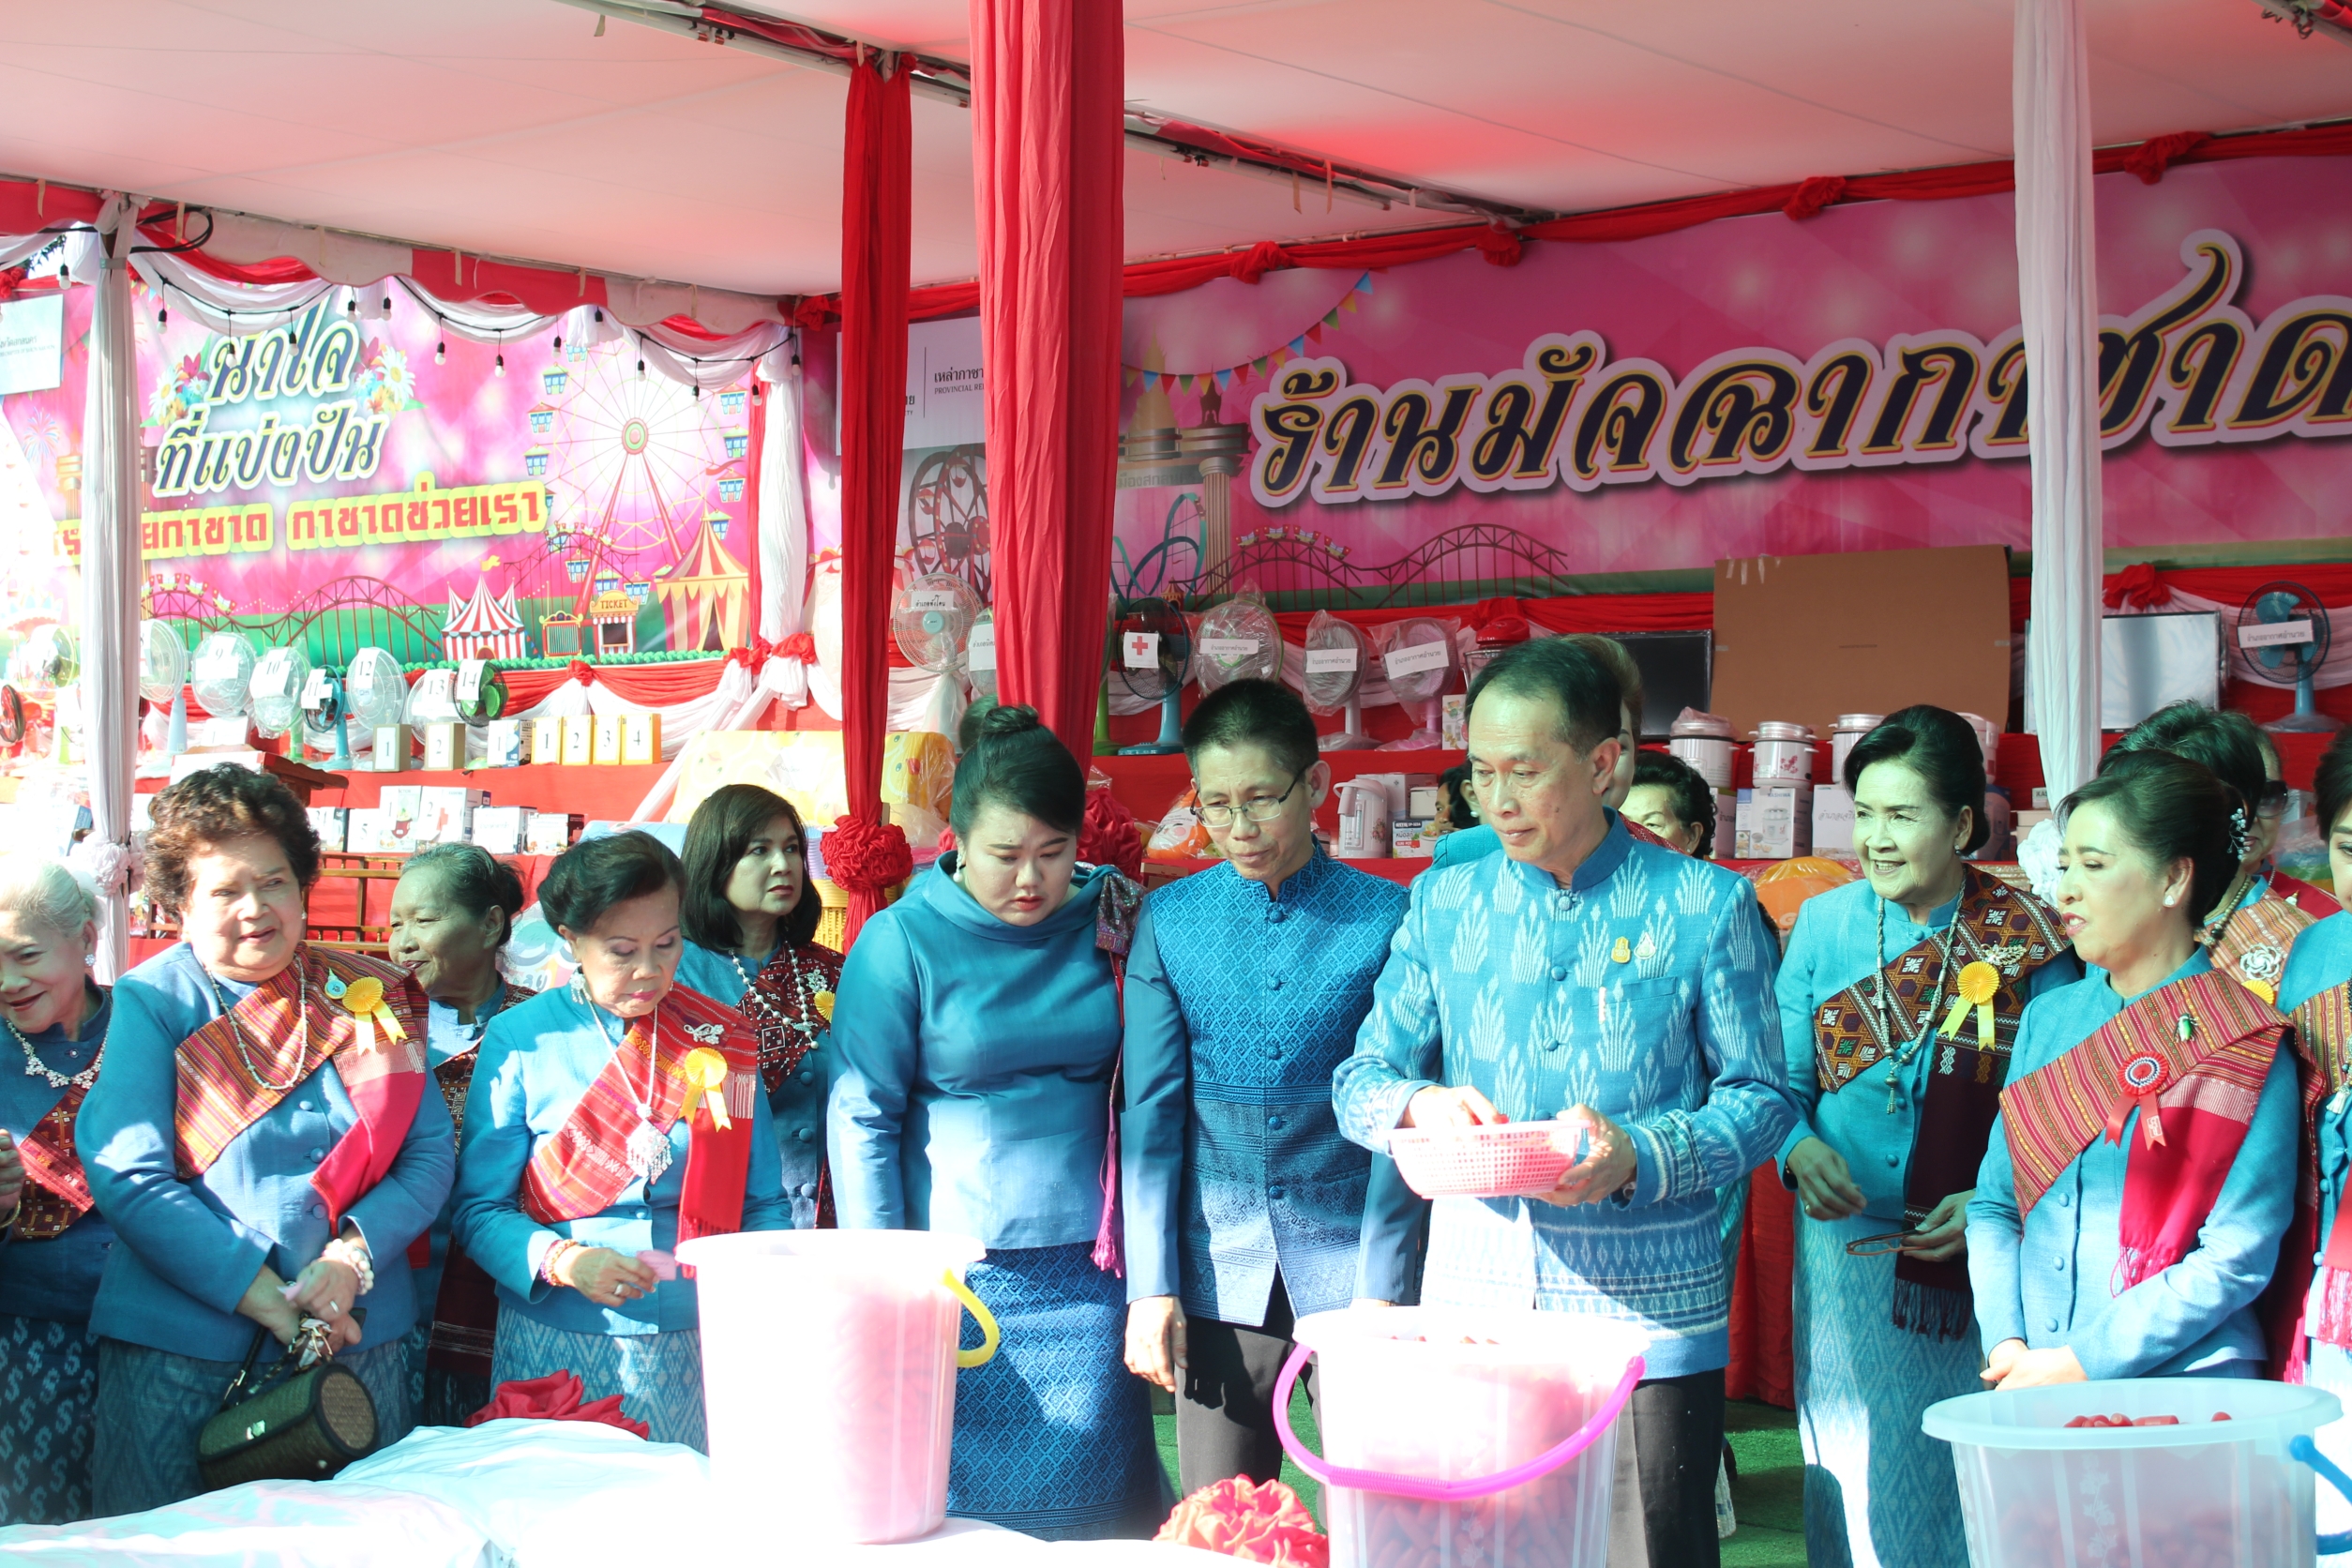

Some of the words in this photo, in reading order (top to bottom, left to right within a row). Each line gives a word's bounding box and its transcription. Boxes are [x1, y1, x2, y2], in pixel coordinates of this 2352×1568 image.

[934, 384, 972, 395] PROVINCIAL
[158, 406, 385, 491] ที่แบ่งปัน
[293, 481, 539, 540] กาชาดช่วยเรา
[600, 599, 628, 609] TICKET
[216, 648, 223, 661] 9
[265, 661, 279, 675] 10
[358, 660, 372, 676] 12
[429, 680, 445, 695] 13
[462, 671, 476, 688] 14
[544, 732, 550, 749] 1
[573, 732, 580, 749] 2
[603, 731, 611, 747] 3
[633, 729, 641, 746] 4
[384, 741, 390, 758] 1
[435, 739, 443, 755] 2
[388, 802, 393, 818] 1
[427, 802, 433, 818] 2
